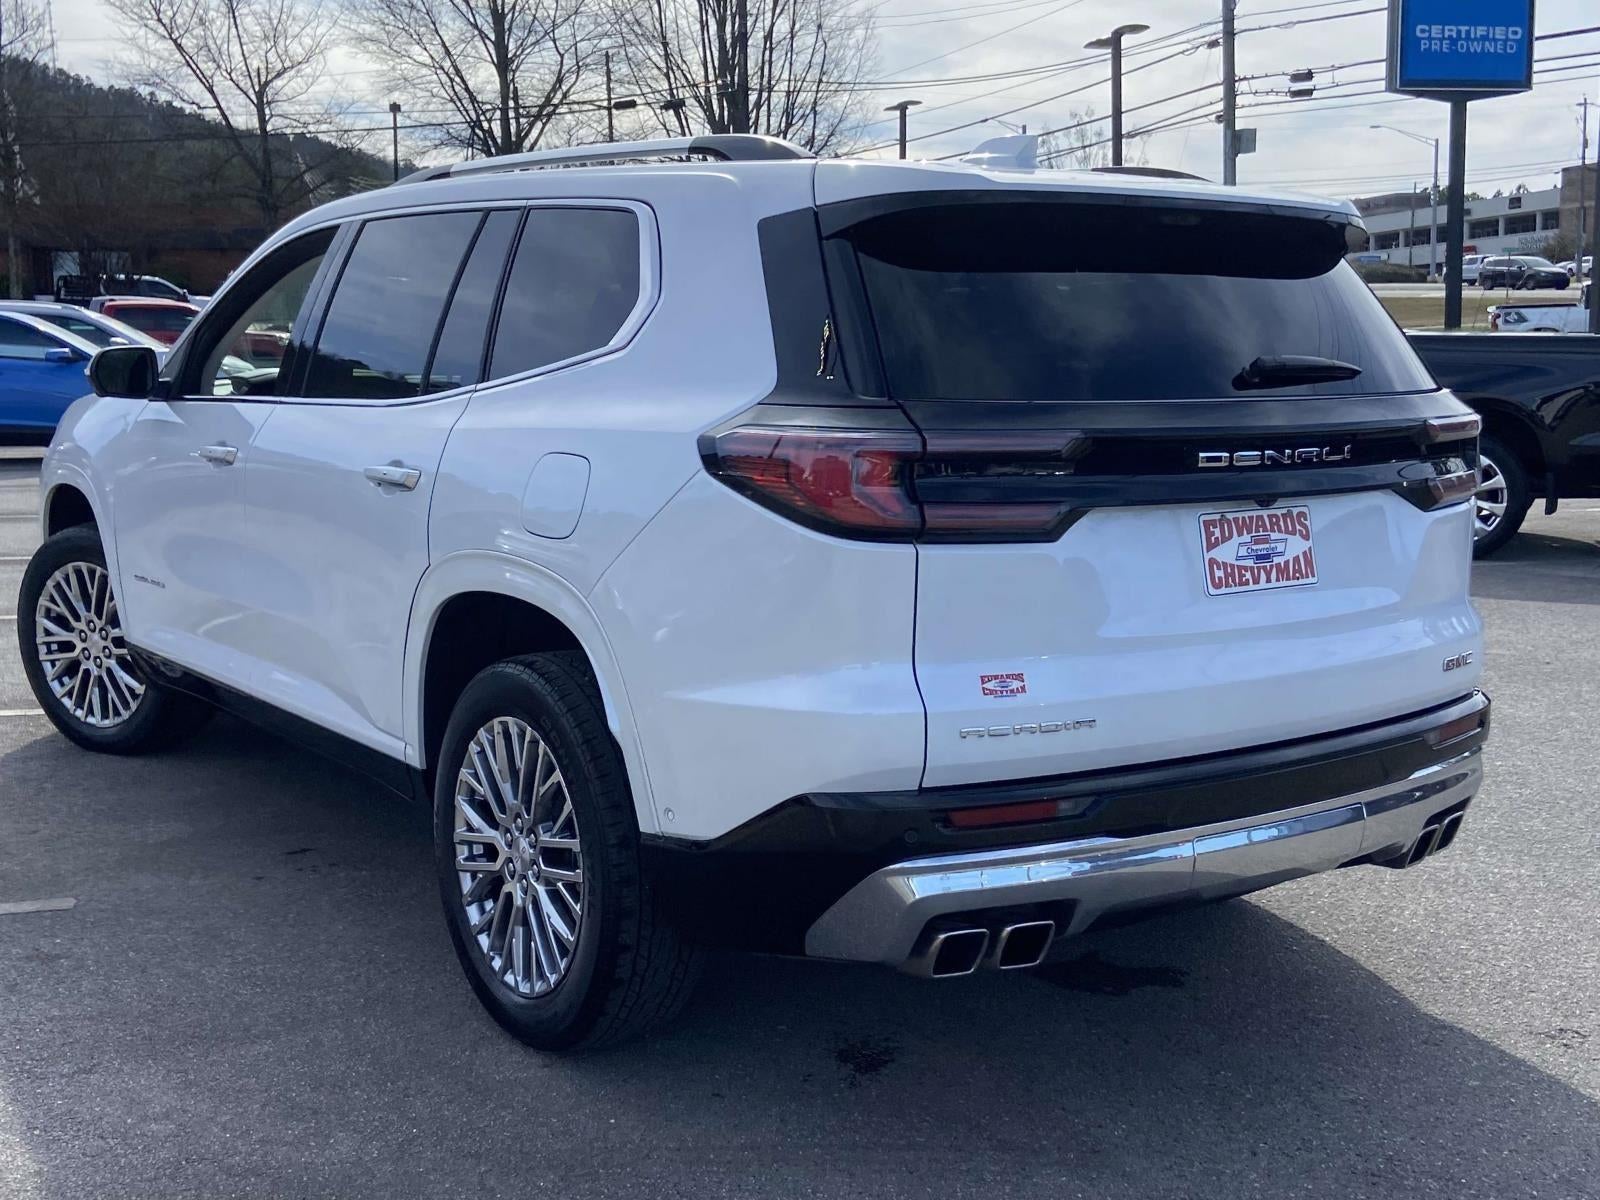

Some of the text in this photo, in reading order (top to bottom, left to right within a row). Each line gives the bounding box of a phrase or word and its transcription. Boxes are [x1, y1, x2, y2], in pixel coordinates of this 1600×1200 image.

[1415, 24, 1523, 40] CERTIFIED
[1420, 40, 1517, 54] PRE-OWNED
[1198, 444, 1353, 469] DENALI
[1203, 510, 1310, 554] EDWARDS
[1246, 545, 1278, 555] Chevrolet
[1208, 546, 1316, 590] CHEVYMAN
[1443, 650, 1473, 672] GMC
[980, 673, 1025, 686] EDWARDS
[982, 684, 1027, 696] CHEVYMAN
[959, 718, 1097, 739] ACADIA
